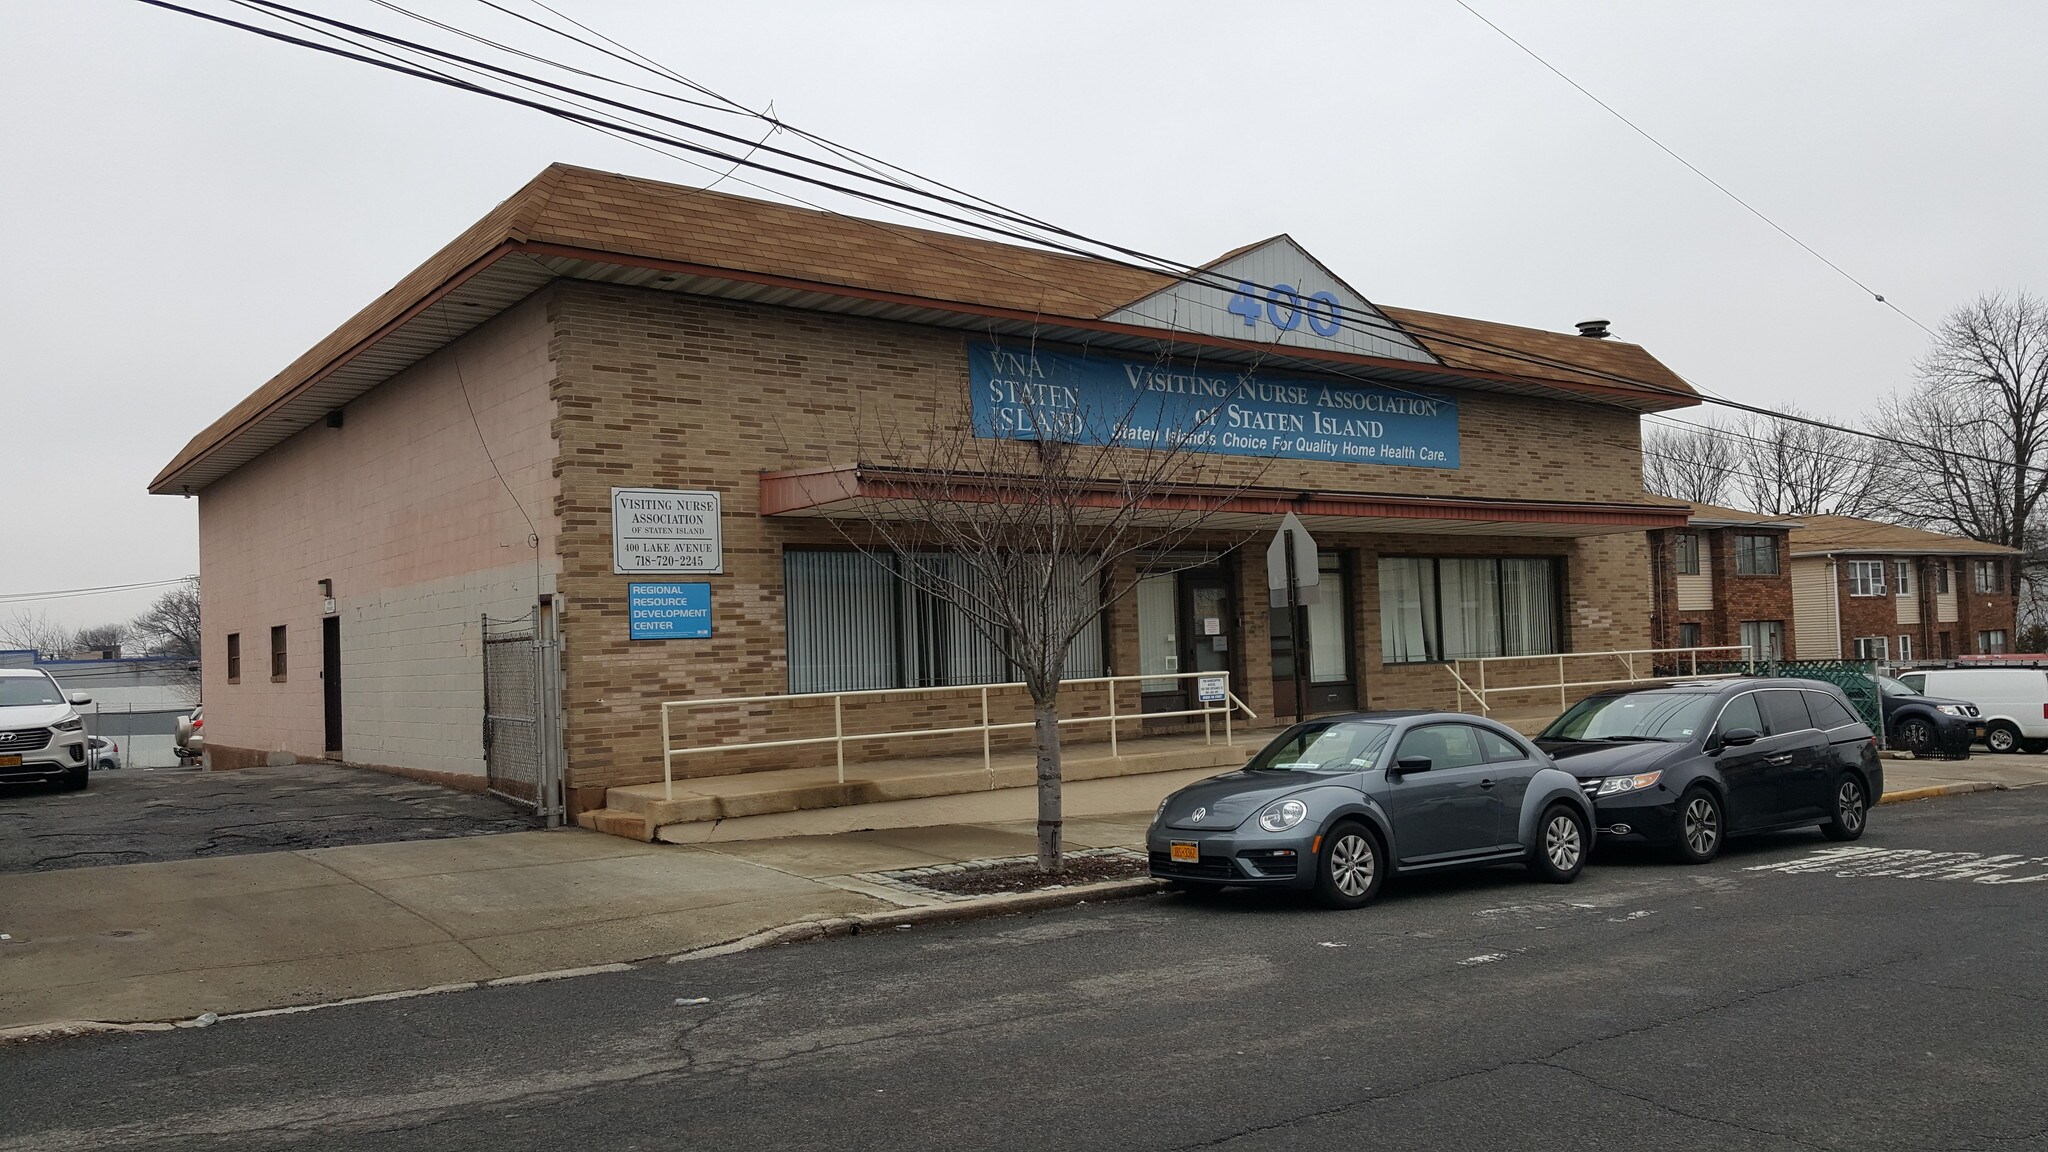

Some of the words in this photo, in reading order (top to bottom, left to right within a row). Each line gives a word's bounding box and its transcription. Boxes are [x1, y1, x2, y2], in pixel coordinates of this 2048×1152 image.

[1228, 280, 1341, 337] 400
[989, 351, 1045, 378] VNA
[989, 379, 1079, 409] STATEN
[1123, 364, 1226, 397] VISITING
[1237, 373, 1308, 405] NURSE
[1317, 384, 1438, 417] ASSOCIATION
[991, 407, 1083, 435] ISLAND
[1228, 404, 1304, 432] STATEN
[1312, 411, 1383, 438] ISLAND
[1112, 422, 1159, 442] Staten
[1166, 427, 1216, 446] Island's
[1223, 432, 1267, 450] Choice
[1273, 436, 1293, 452] For
[1296, 437, 1338, 457] Quality
[1343, 441, 1375, 457] Home
[1380, 444, 1415, 460] Health
[1420, 446, 1447, 462] Care.
[620, 498, 672, 511] VISITING
[677, 500, 714, 512] NURSE
[632, 513, 704, 525] ASSOCIATION
[631, 526, 642, 534] OF
[676, 527, 705, 535] ISLAND
[625, 543, 640, 552] 400
[643, 543, 670, 552] LAKE
[674, 543, 713, 553] AVENUE
[635, 555, 703, 567] 718-720-2245
[633, 586, 684, 595] REGIONAL
[633, 597, 688, 607] RESOURCE
[633, 609, 708, 619] DEVELOPMENT
[634, 621, 673, 630] CENTER
